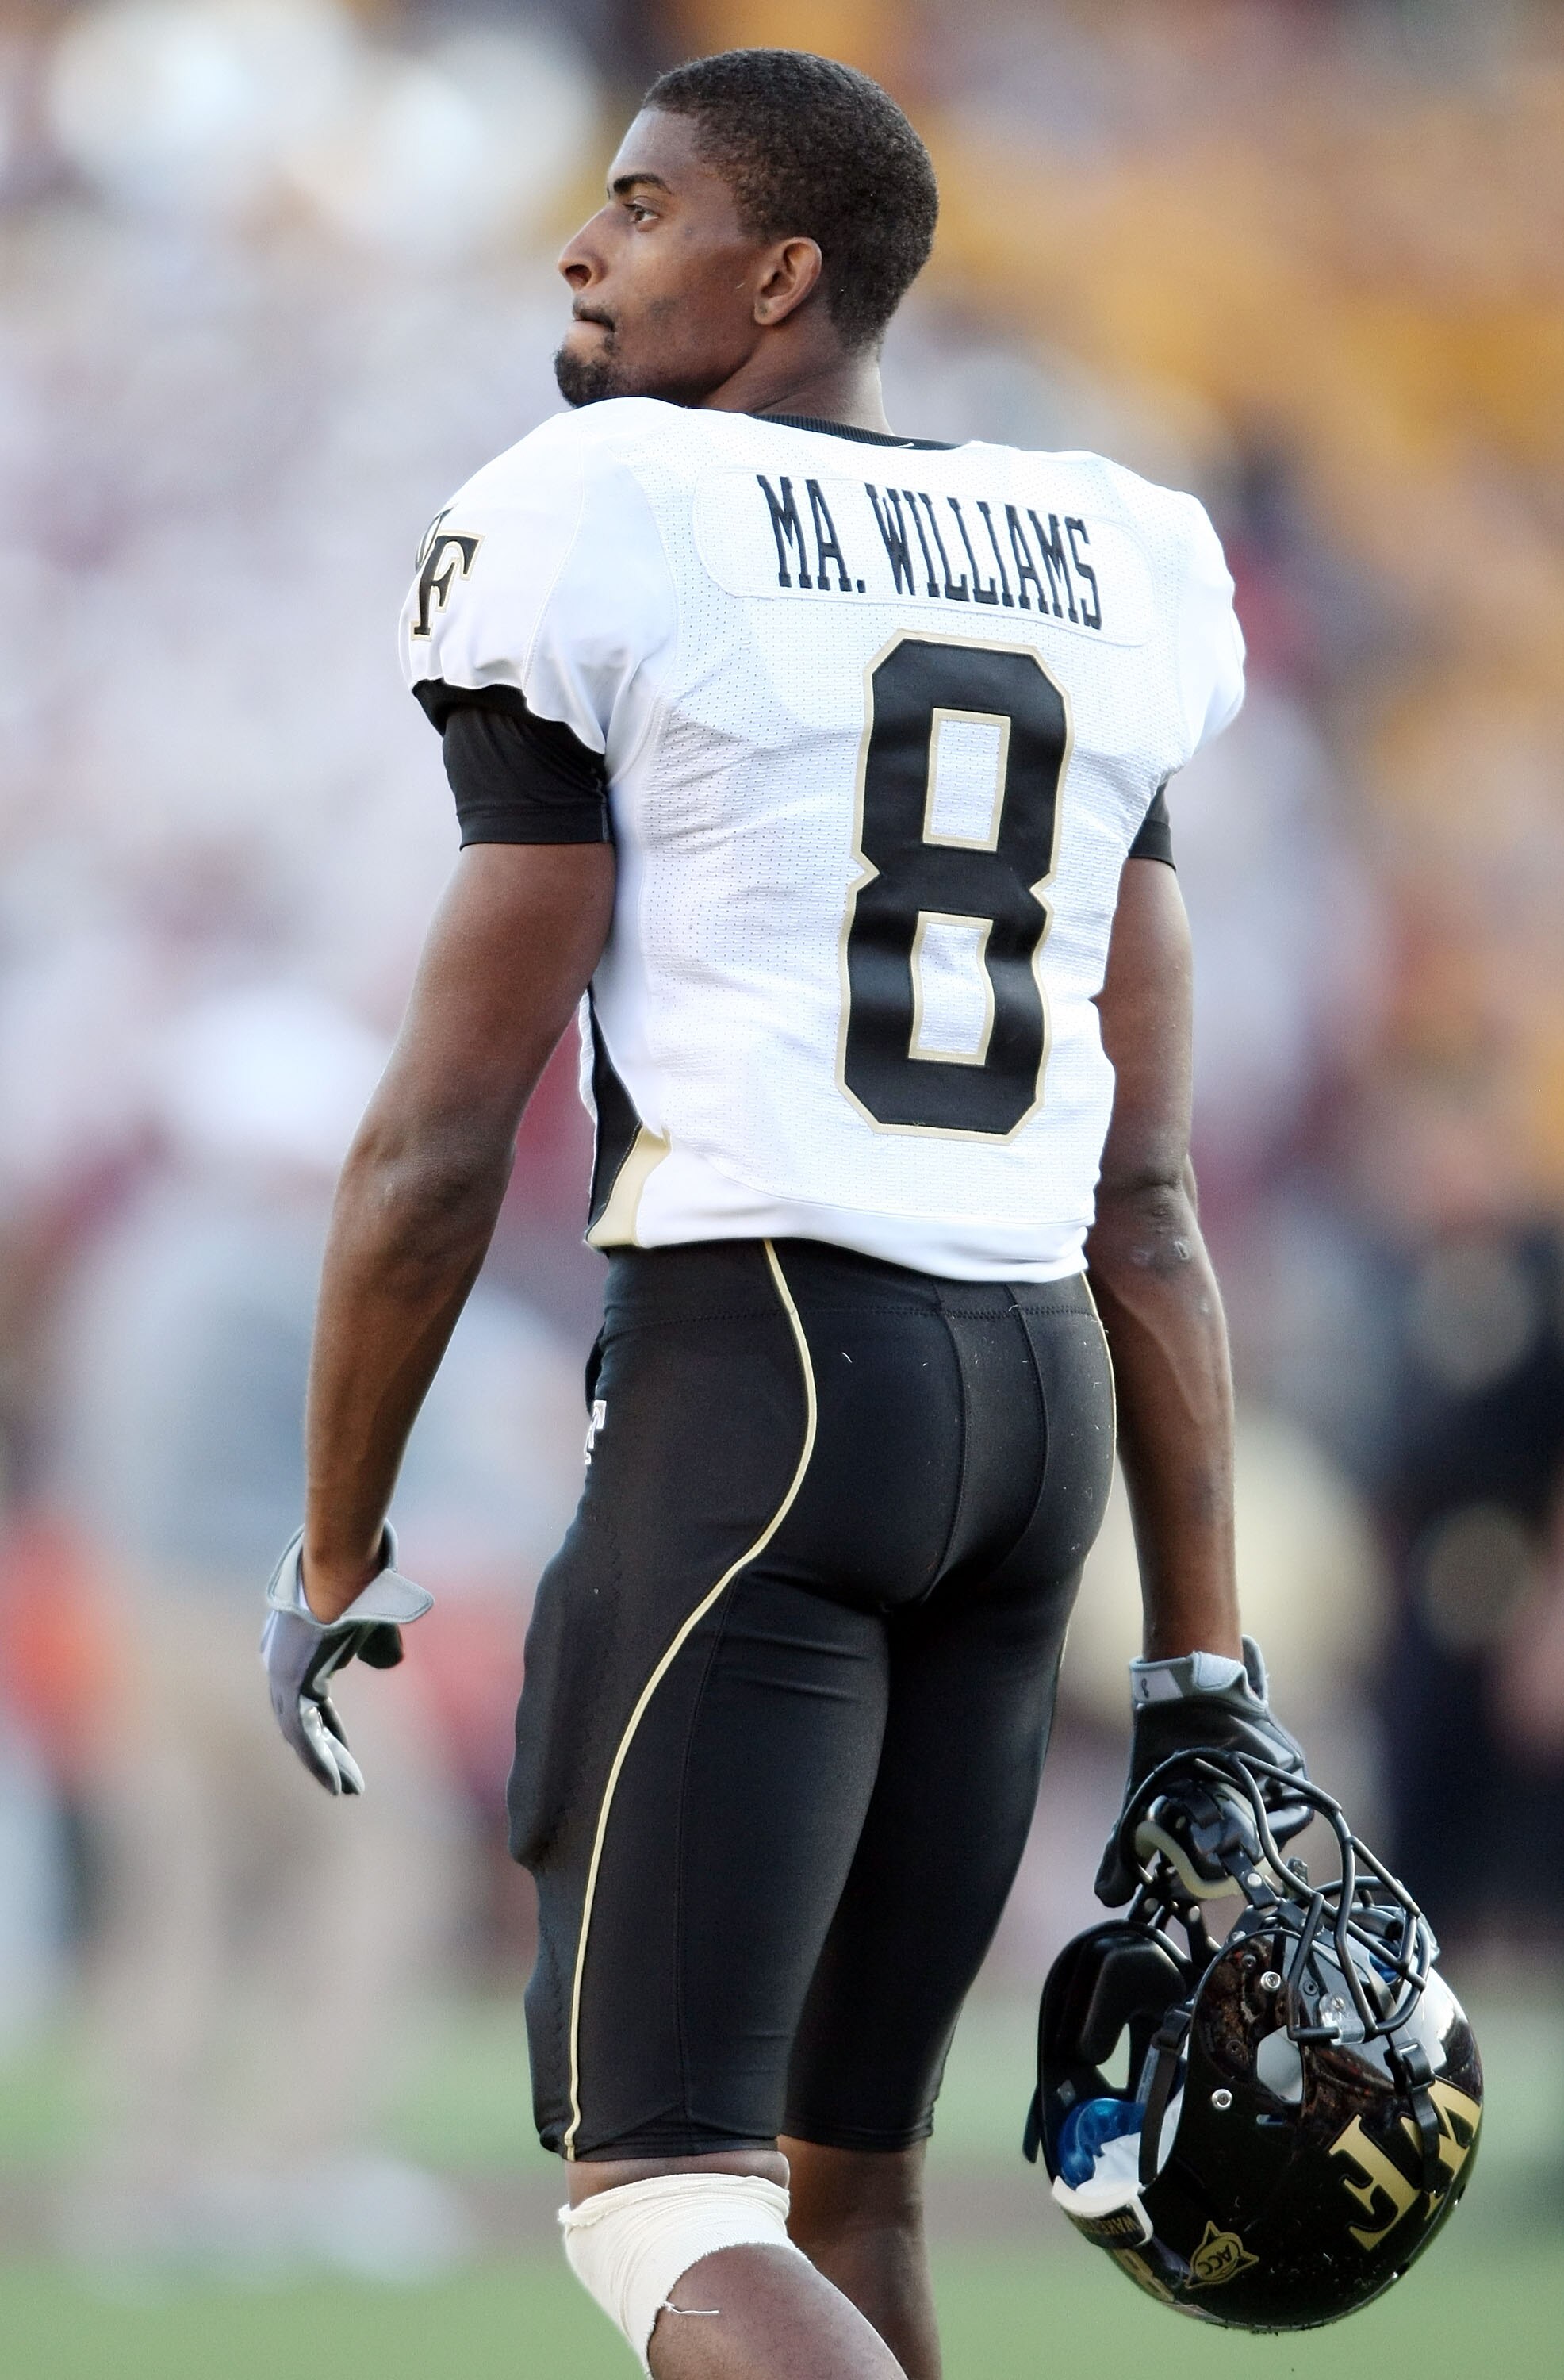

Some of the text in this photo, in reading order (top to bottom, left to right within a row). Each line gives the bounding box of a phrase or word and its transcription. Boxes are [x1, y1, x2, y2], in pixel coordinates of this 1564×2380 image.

[756, 474, 1102, 630] MA. WILLIAMS
[837, 629, 1075, 1145] 8
[1198, 2244, 1232, 2276] ACC
